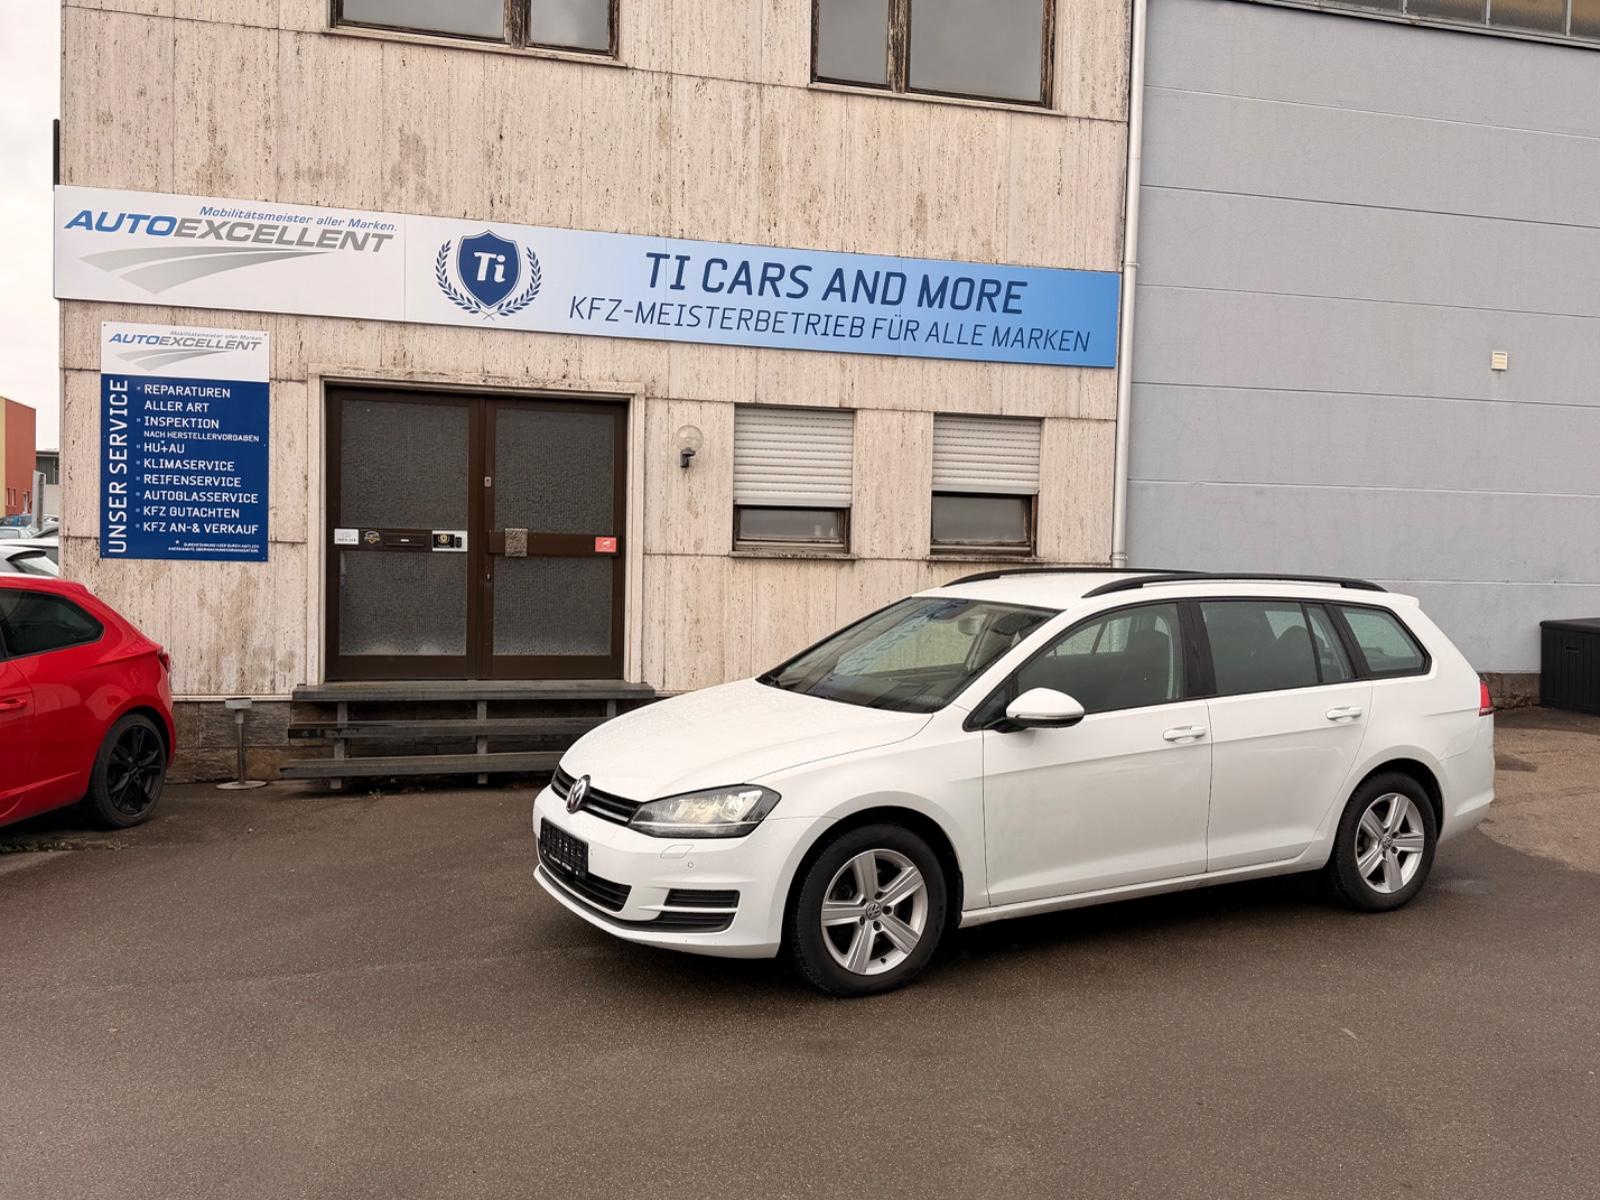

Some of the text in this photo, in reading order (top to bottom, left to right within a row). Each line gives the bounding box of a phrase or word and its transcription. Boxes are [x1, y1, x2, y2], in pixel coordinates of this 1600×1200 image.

[199, 205, 314, 226] Mobilitätsmeister
[316, 213, 346, 227] aller
[64, 209, 395, 253] AUTOEXCELLENT
[473, 251, 506, 283] Ti
[646, 251, 1029, 315] TI CARS AND MORE
[569, 295, 1091, 353] KFZ-MEISTERBETRIEB FÜR ALLE MARKEN
[144, 383, 231, 398] REPARATUREN
[144, 401, 210, 413] ALLER ART
[144, 415, 220, 429] INSPEKTION
[143, 430, 260, 443] NACH HERSTELLERVORGABEN
[108, 379, 129, 554] UNSER SERVICE
[143, 458, 235, 472] KLIMASERVICE
[143, 474, 242, 487] REIFENSERVICE
[143, 490, 259, 504] AUTOGLASSERVICE
[143, 506, 240, 518] KFZ GUTACHTEN
[143, 521, 166, 532] KFZ
[203, 523, 259, 535] VERKAUF
